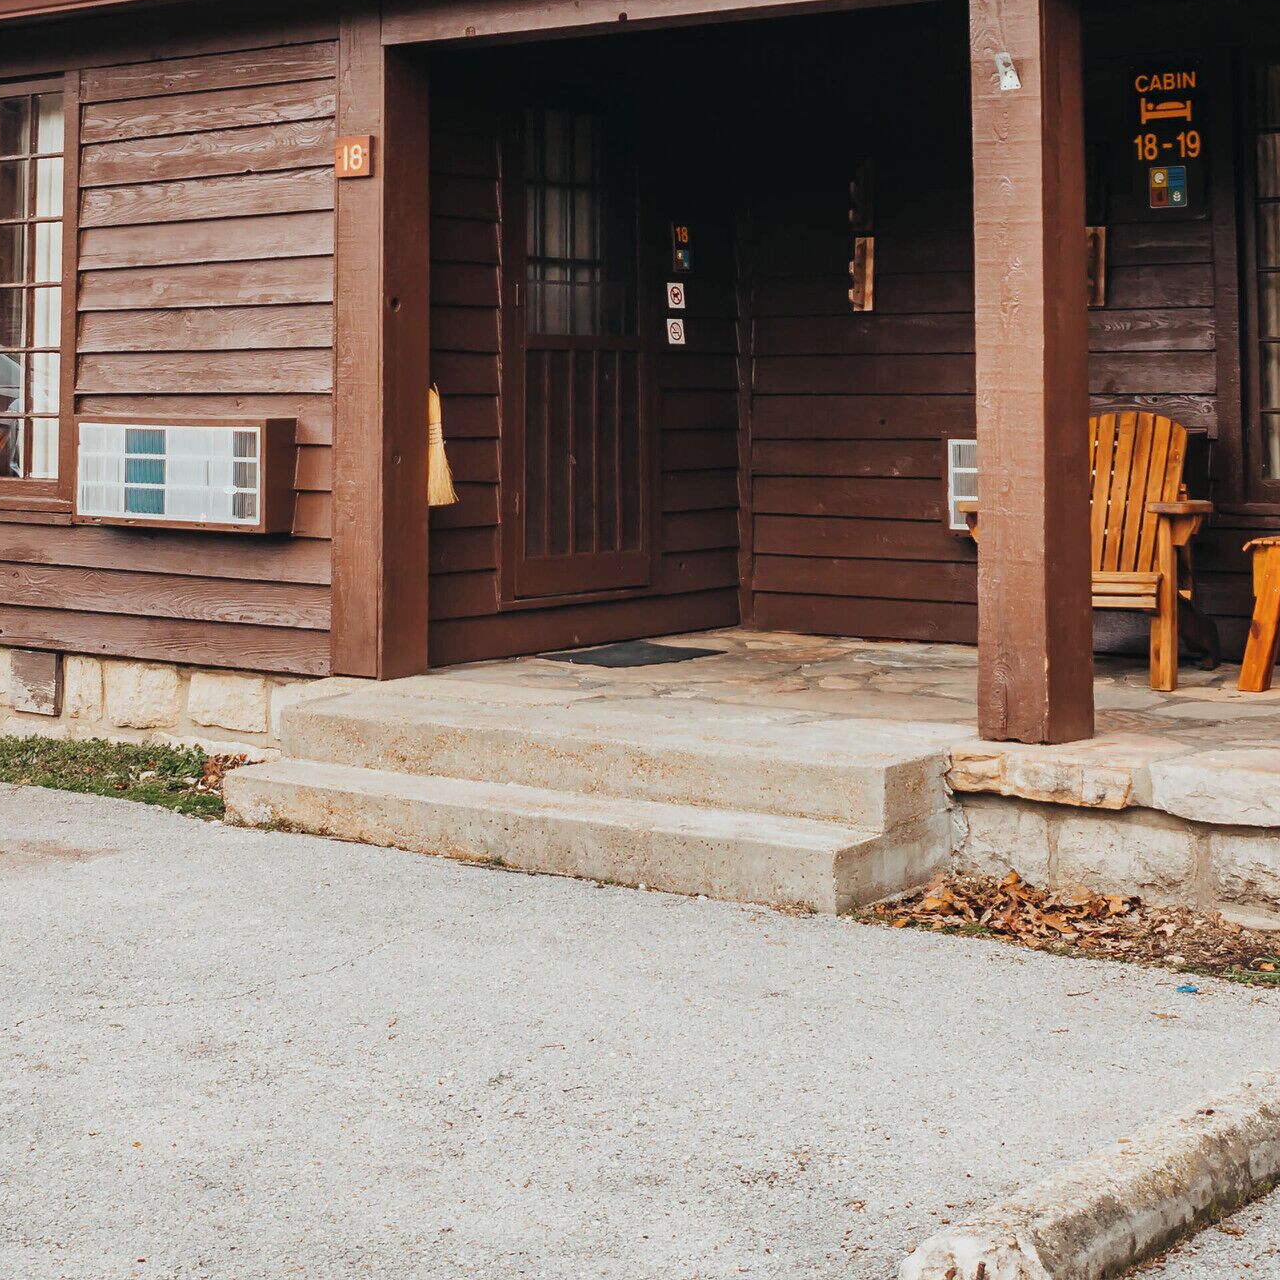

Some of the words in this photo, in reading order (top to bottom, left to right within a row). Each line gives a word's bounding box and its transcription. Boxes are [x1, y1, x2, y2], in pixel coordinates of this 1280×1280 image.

[1135, 71, 1196, 92] CABIN
[343, 143, 363, 170] 18
[676, 226, 688, 243] 18
